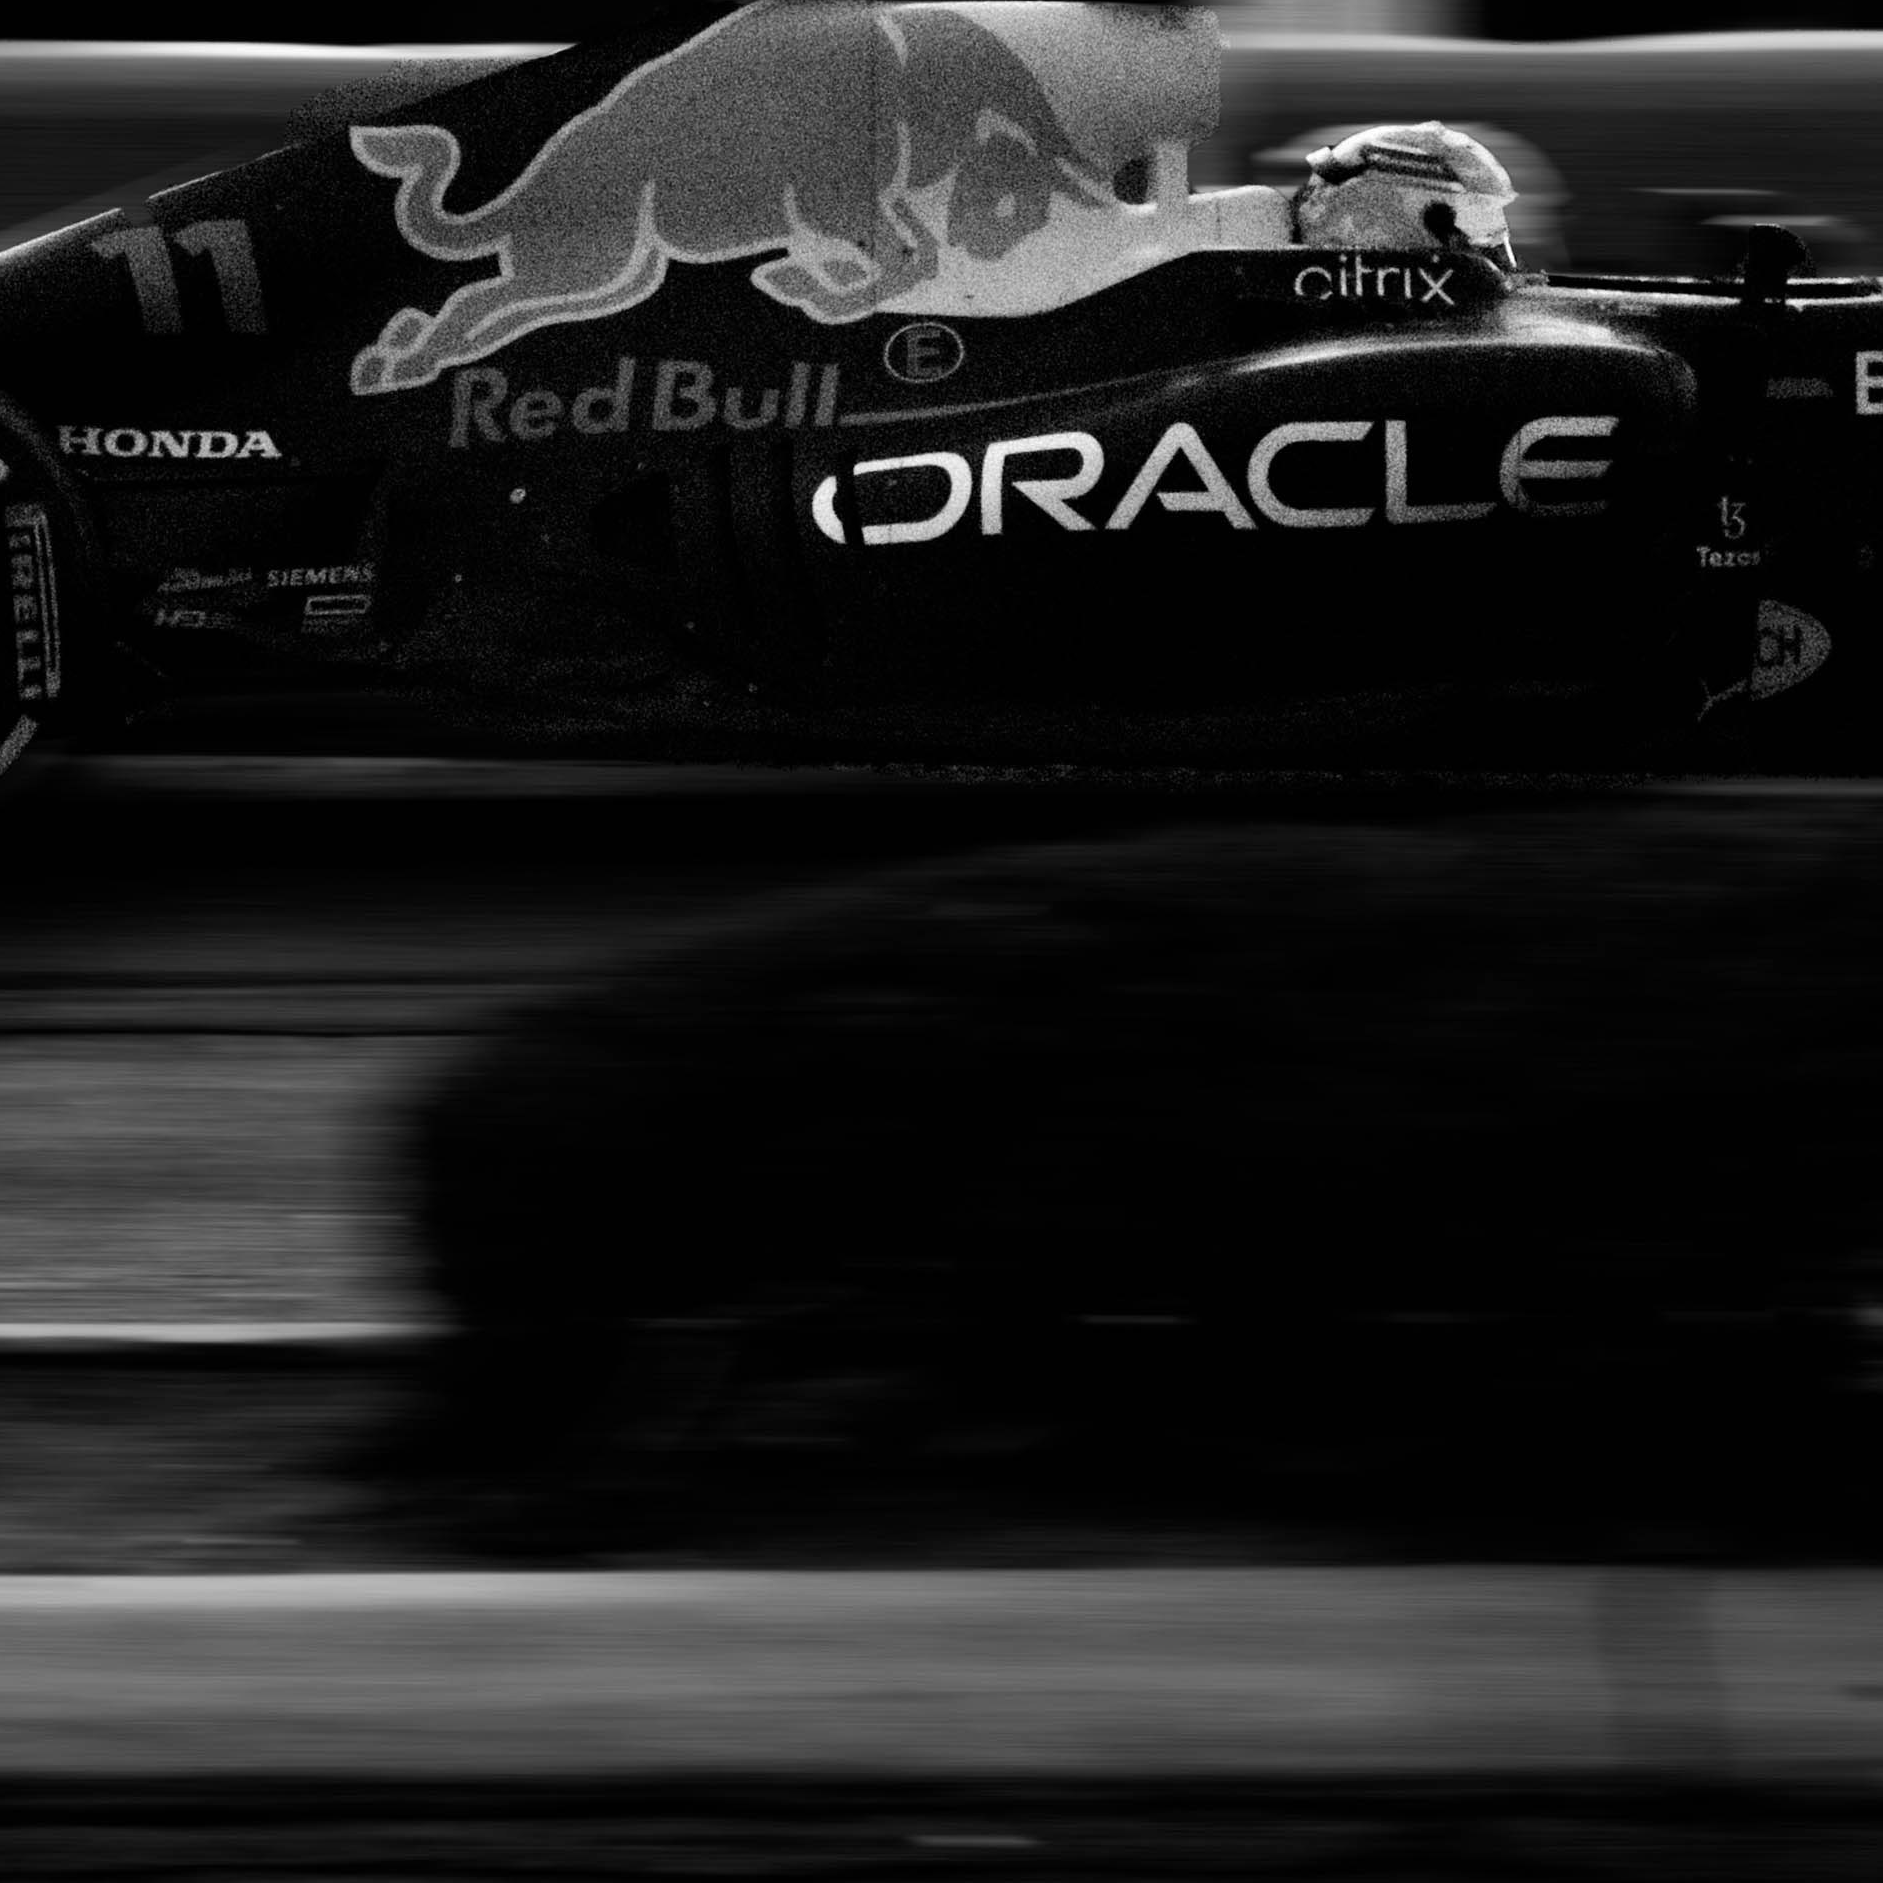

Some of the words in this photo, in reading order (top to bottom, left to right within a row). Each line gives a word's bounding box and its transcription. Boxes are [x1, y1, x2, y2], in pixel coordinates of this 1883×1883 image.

[90, 217, 270, 336] 11
[1292, 253, 1457, 307] citrix
[55, 424, 283, 460] HONDA
[448, 355, 637, 449] Red
[650, 359, 841, 433] Bull
[810, 414, 1623, 546] ORACLE
[4, 501, 63, 702] PIRELLI
[265, 562, 377, 589] SIEMENS
